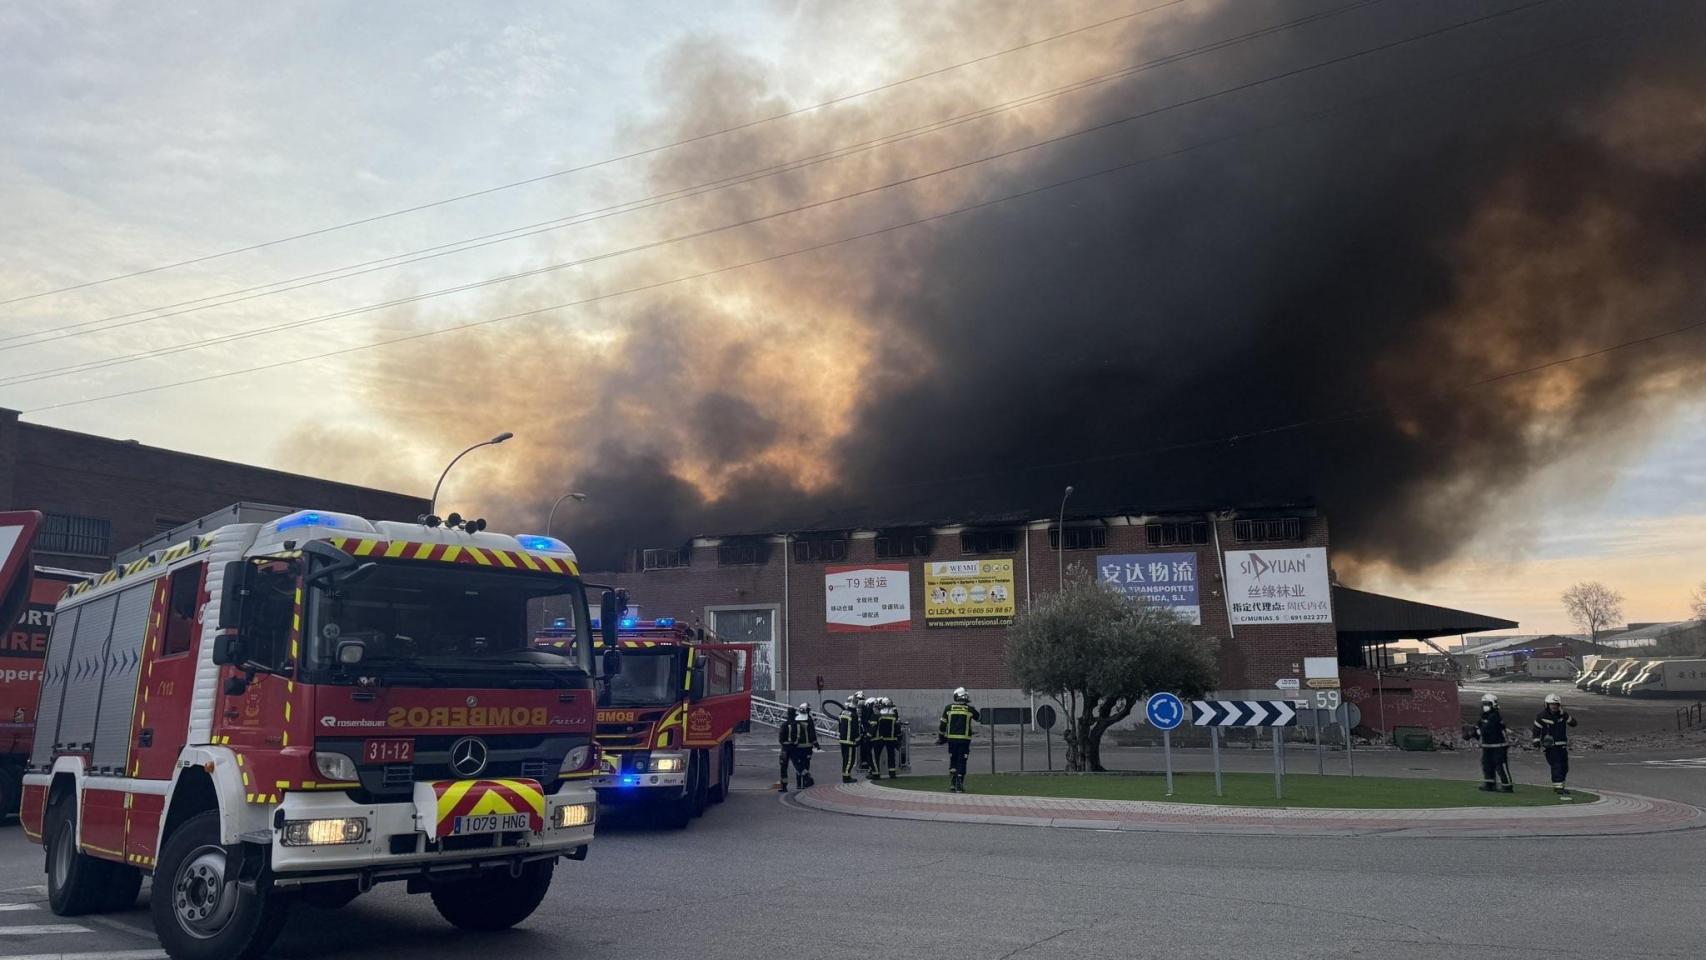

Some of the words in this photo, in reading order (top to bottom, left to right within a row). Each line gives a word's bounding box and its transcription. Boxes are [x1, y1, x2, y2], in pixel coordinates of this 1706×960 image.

[1102, 562, 1193, 583] 安达物流
[846, 578, 860, 589] T9
[863, 576, 888, 589] 速运
[18, 610, 54, 626] RT
[1316, 691, 1339, 710] 59
[337, 719, 385, 727] rosenbauer
[369, 742, 409, 760] 31-12
[466, 816, 497, 832] 1079
[502, 815, 526, 829] HNG
